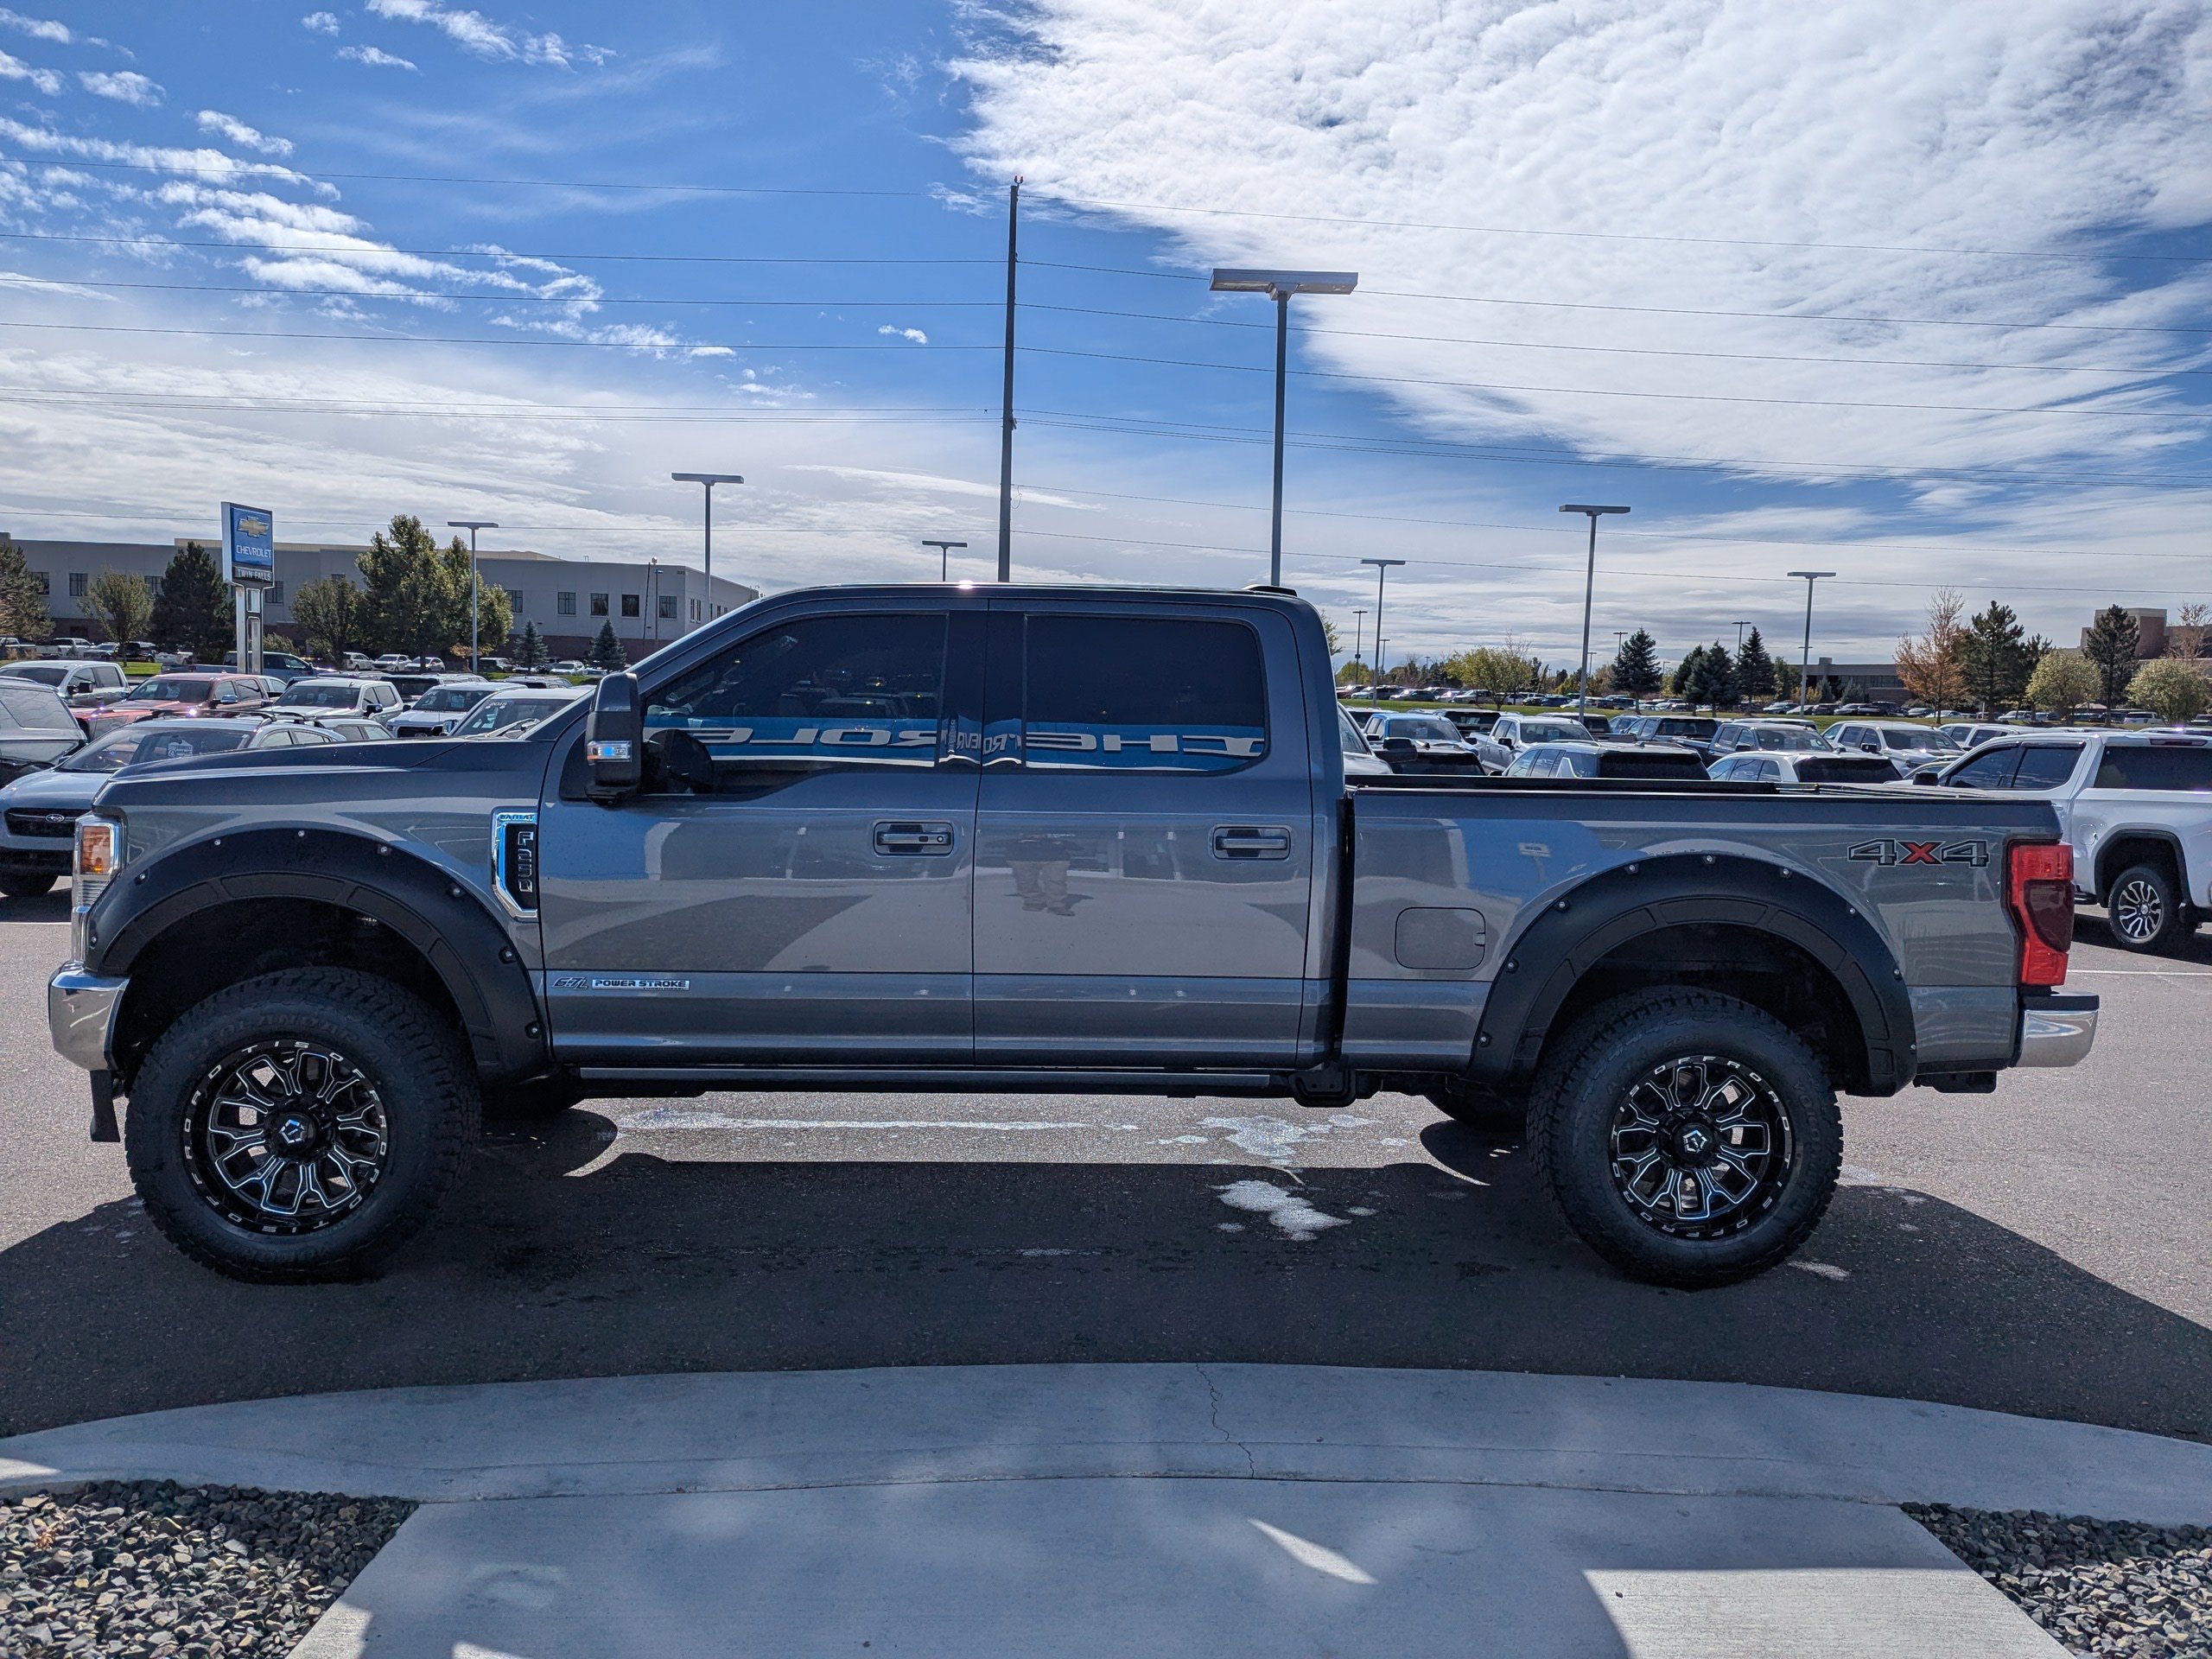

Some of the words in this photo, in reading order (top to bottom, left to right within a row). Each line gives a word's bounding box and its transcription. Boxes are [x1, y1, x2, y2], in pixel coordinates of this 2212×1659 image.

[237, 545, 270, 558] CHEVROLET
[238, 569, 253, 578] TWIN
[254, 570, 271, 581] FALLS
